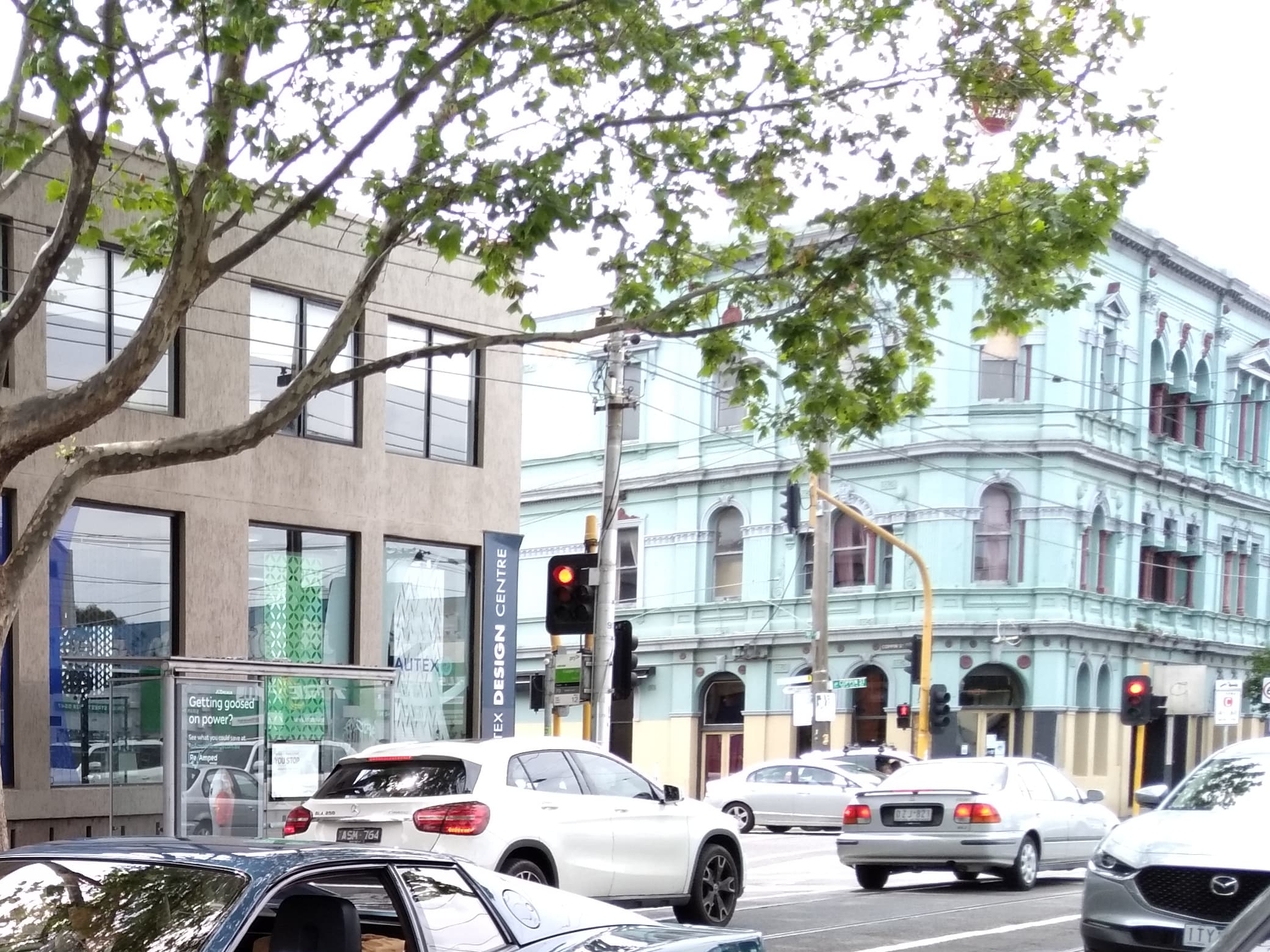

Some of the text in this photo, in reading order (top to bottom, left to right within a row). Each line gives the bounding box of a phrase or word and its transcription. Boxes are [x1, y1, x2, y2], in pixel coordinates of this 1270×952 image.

[495, 548, 507, 617] CENTRE
[394, 657, 440, 673] AUTEX
[493, 624, 506, 706] DESIGN
[189, 696, 255, 711] Getting goosed
[188, 713, 233, 727] on power?
[286, 756, 300, 765] STOP
